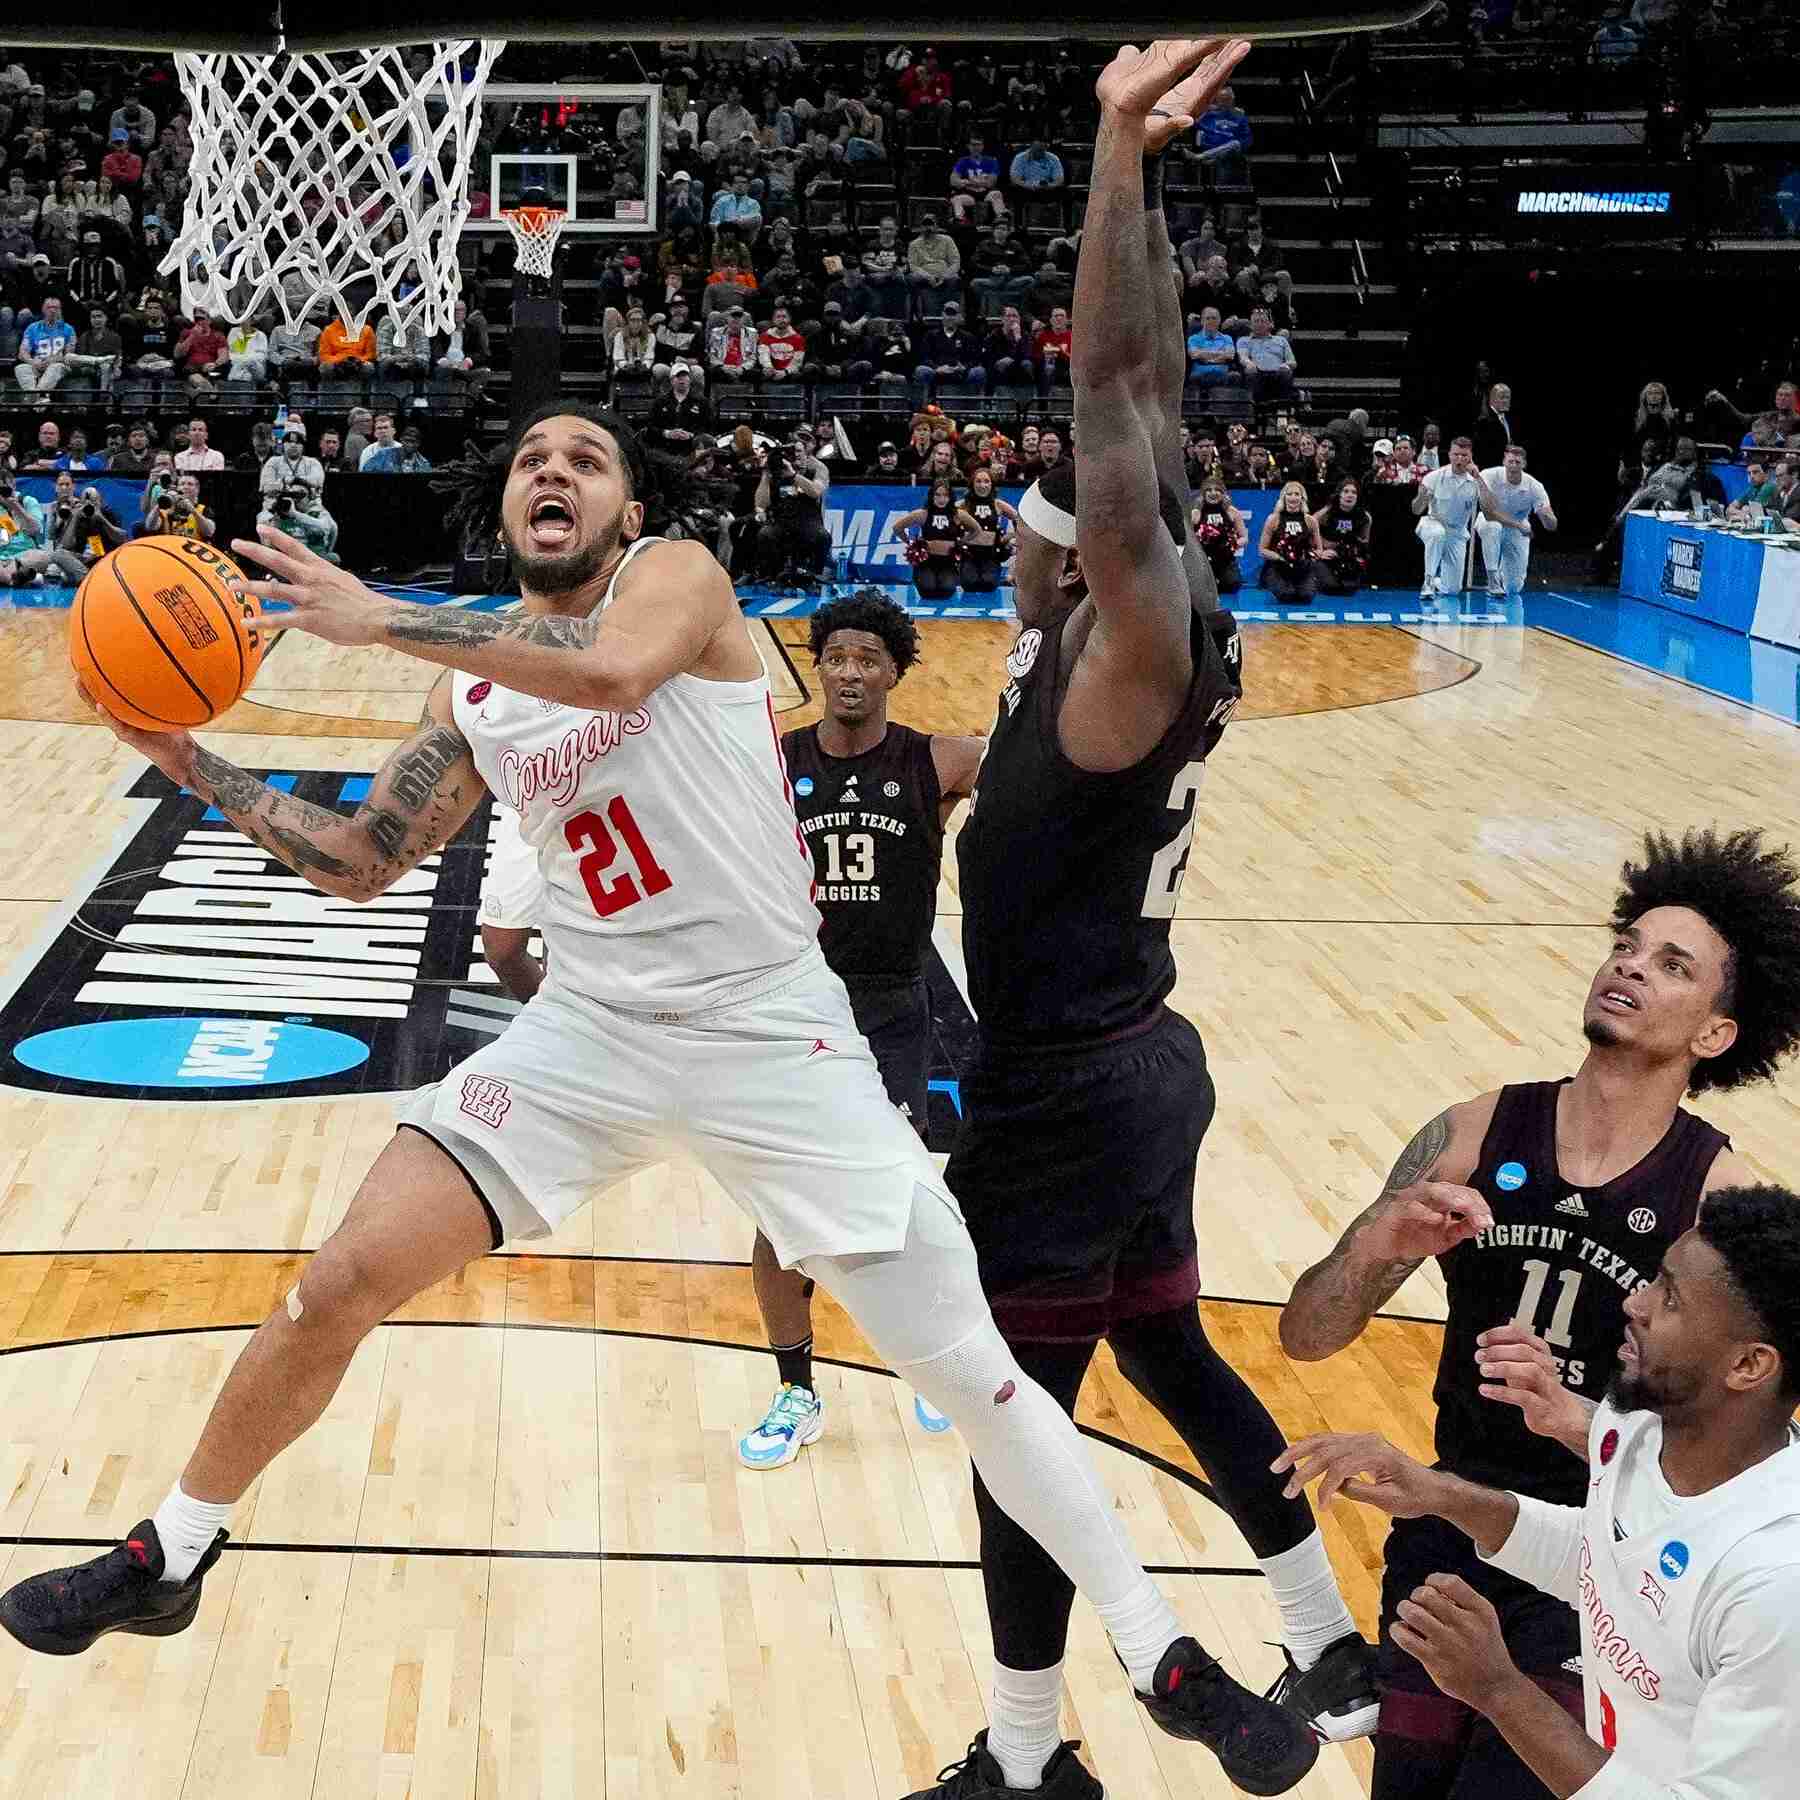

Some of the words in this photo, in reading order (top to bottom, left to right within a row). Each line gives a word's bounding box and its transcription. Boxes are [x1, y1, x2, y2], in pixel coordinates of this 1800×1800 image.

[800, 811, 855, 835] IGHTIN'
[860, 812, 907, 837] TEXAS
[564, 795, 673, 918] 21
[823, 833, 875, 881] 13
[816, 885, 881, 901] AGGIES
[177, 1020, 286, 1082] NCAA
[1554, 1203, 1590, 1218] adidas
[1630, 1210, 1654, 1231] SEC
[1511, 1258, 1583, 1349] 11
